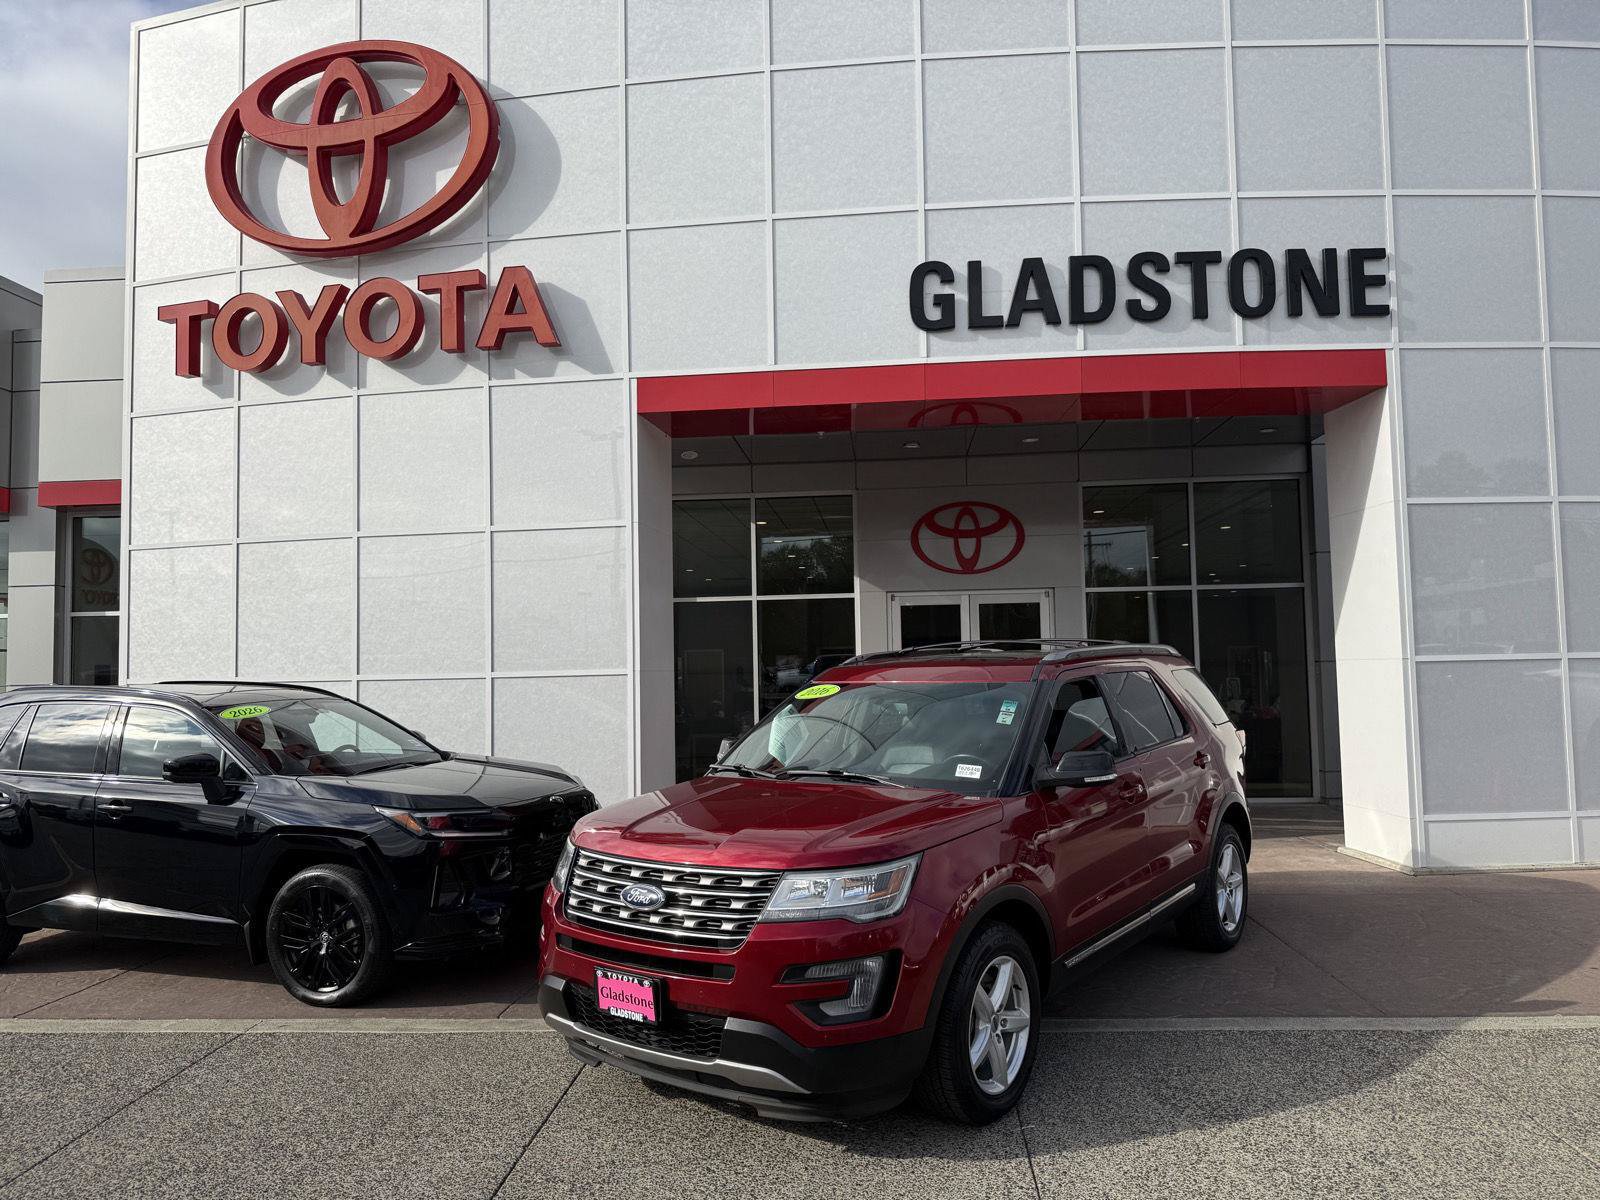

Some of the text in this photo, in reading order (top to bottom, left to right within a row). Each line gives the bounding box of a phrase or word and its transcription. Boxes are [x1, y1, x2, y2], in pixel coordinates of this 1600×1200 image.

[909, 247, 1391, 332] GLADSTONE
[157, 265, 561, 379] TOYOTA
[229, 706, 263, 718] 2026
[627, 887, 651, 904] Ford
[607, 972, 638, 984] TOYOTA
[600, 986, 654, 1009] Gladstone
[610, 1006, 644, 1022] GLADSTONE
